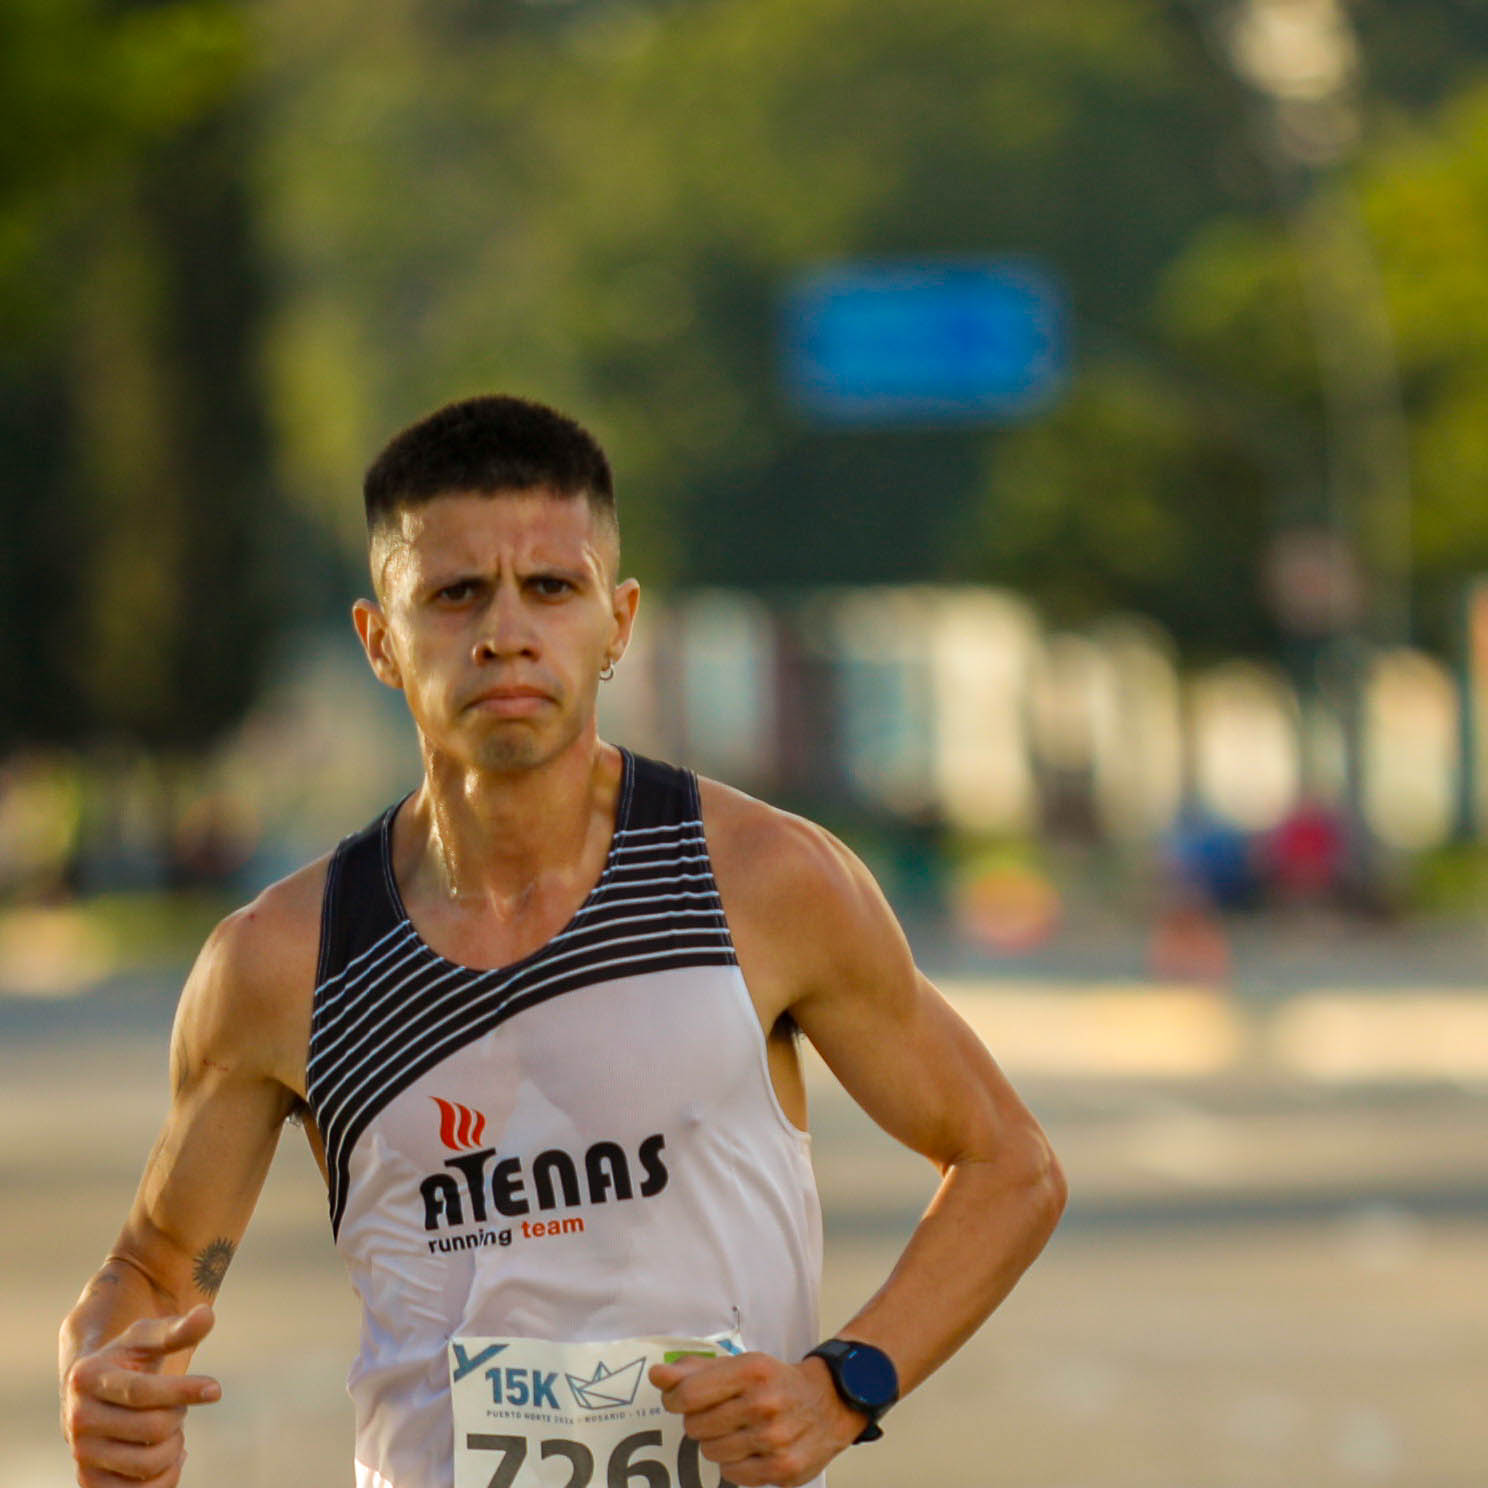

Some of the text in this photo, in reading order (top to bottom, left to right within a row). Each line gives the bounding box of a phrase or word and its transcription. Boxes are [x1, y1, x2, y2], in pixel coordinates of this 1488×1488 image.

[428, 1216, 585, 1254] running team
[484, 1366, 561, 1410] 15K
